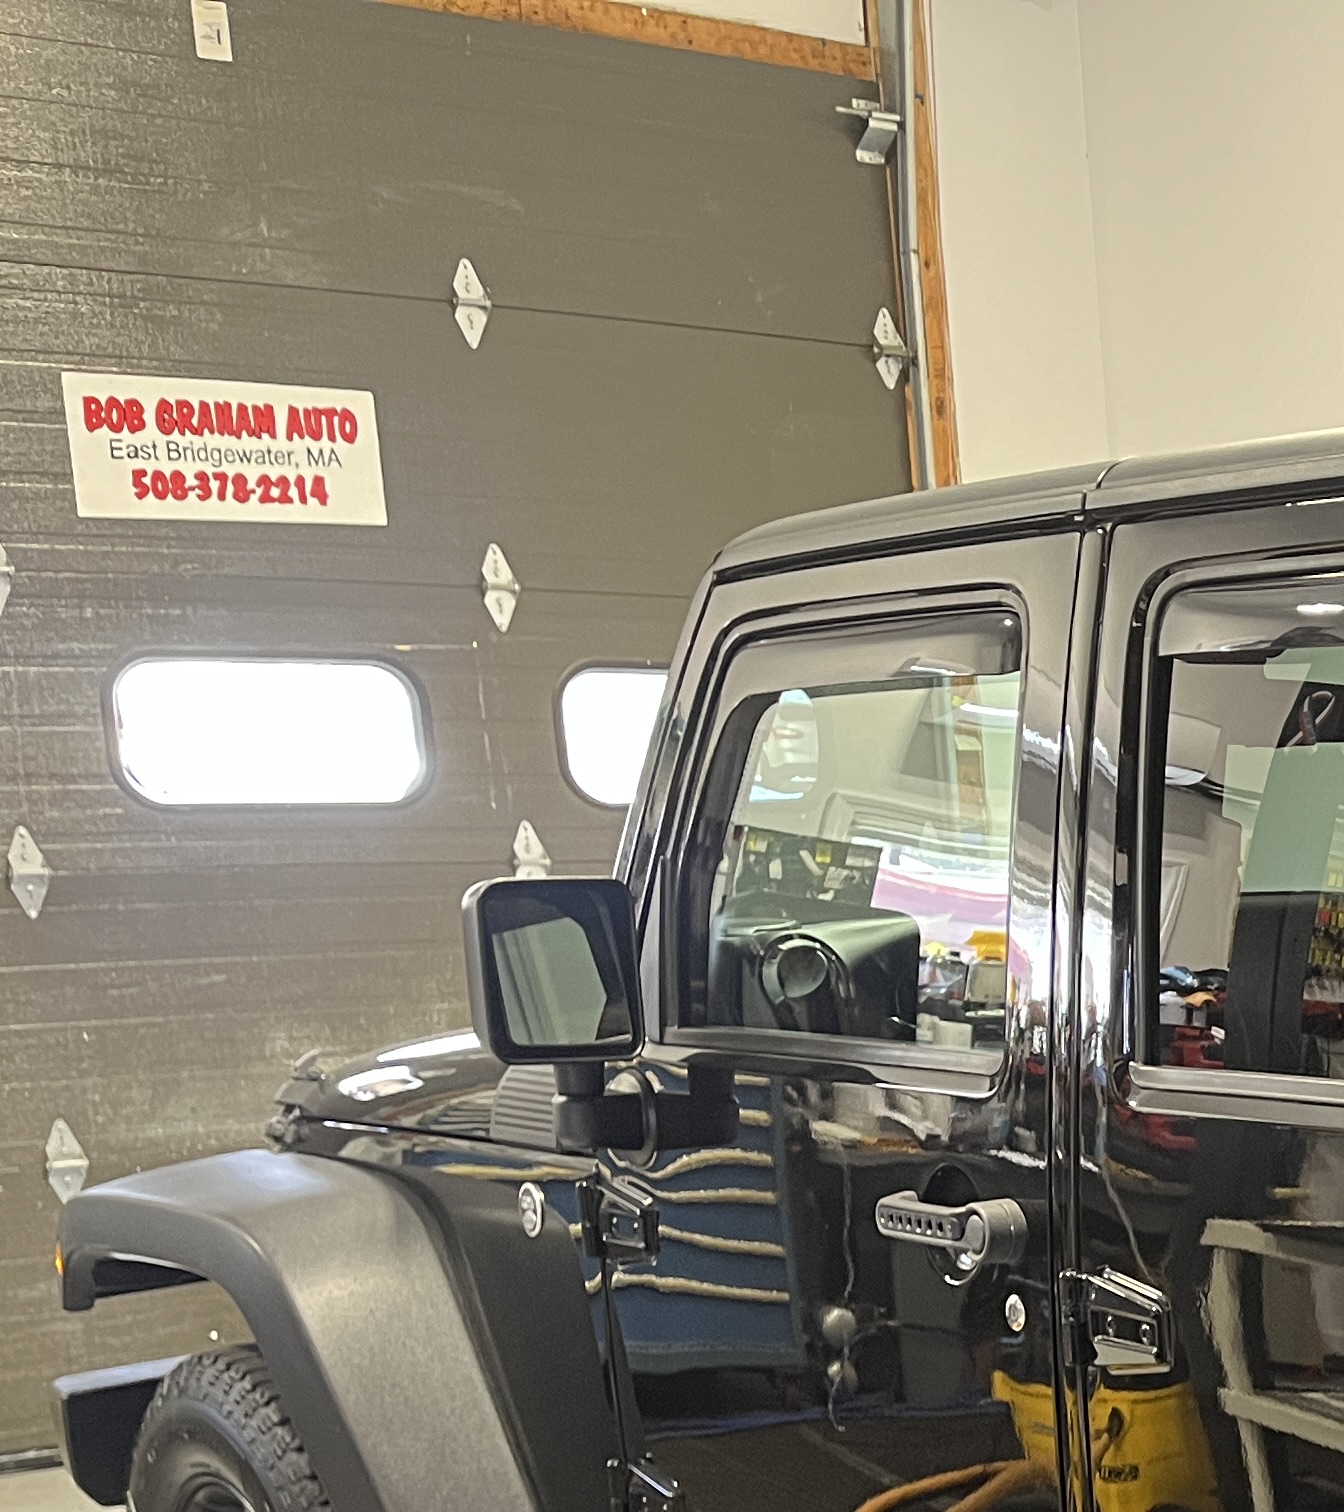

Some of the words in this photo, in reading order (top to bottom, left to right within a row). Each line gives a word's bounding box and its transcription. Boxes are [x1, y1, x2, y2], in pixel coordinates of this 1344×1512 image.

[82, 396, 146, 434] BOB
[155, 398, 277, 440] GRAHAM
[286, 404, 359, 444] AUTO
[109, 438, 159, 462] East
[167, 440, 299, 468] Bridgewater,
[307, 446, 343, 469] MA
[131, 468, 330, 507] 508-378-2214
